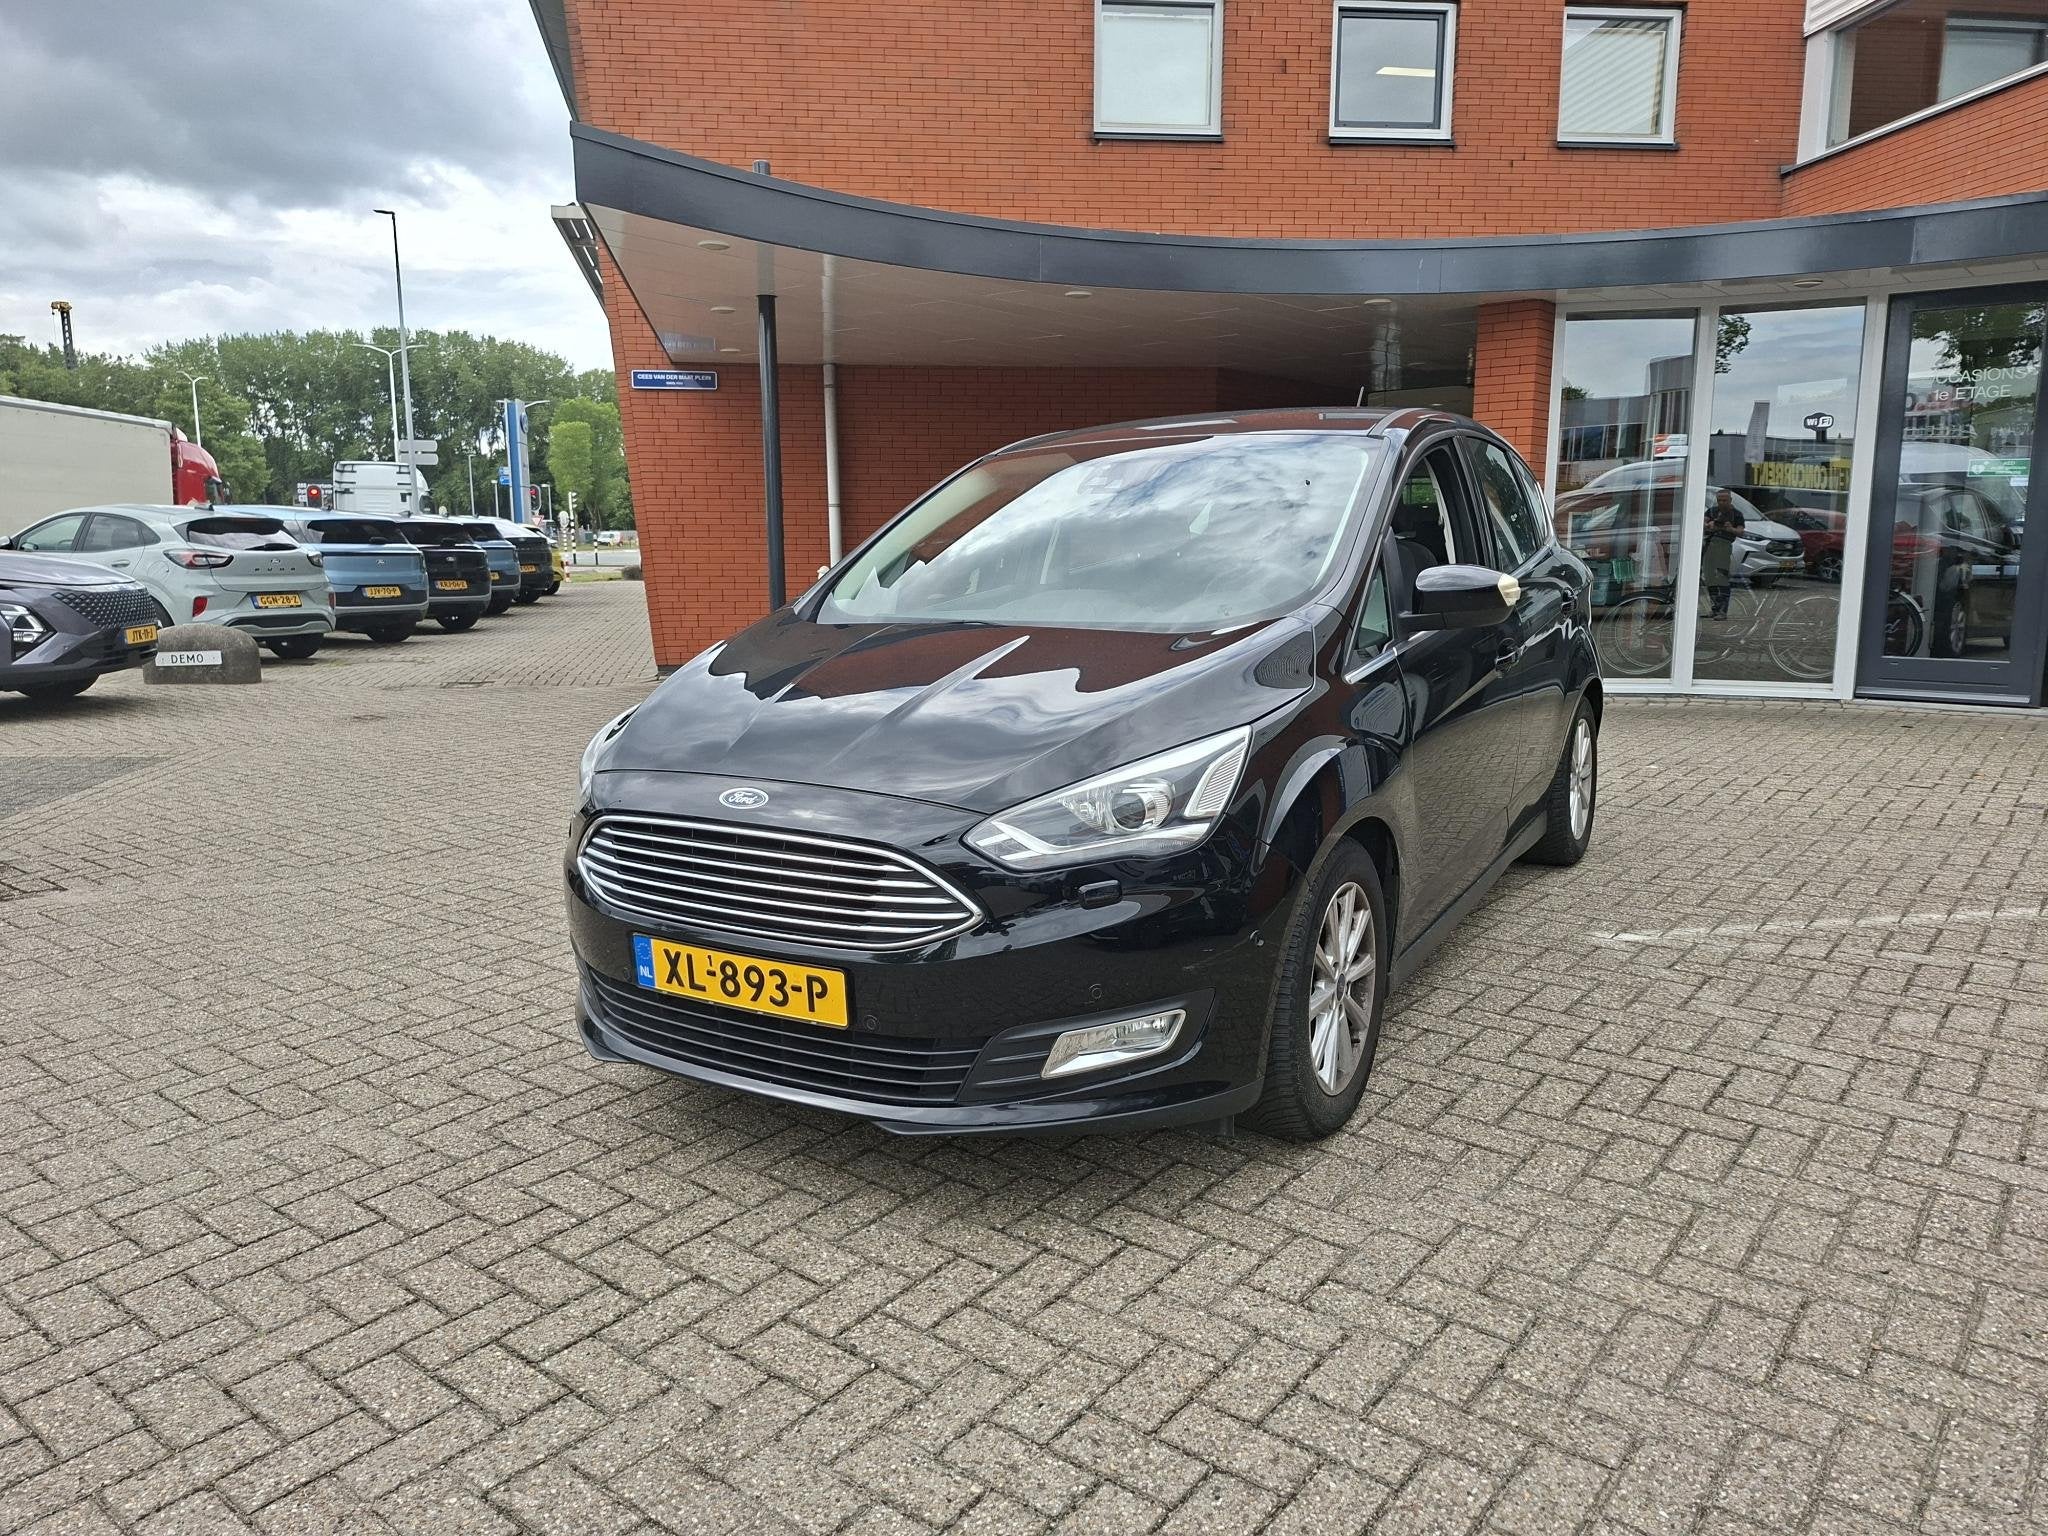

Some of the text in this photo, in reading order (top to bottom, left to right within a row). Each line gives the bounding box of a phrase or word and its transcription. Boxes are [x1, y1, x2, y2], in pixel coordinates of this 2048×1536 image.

[1933, 384, 2012, 401] 1e ETAGE
[260, 595, 299, 605] GGN-28-Z
[170, 654, 204, 664] DEMO
[728, 791, 758, 804] Ford
[639, 965, 653, 979] NL
[662, 947, 829, 1013] XL-893-P
